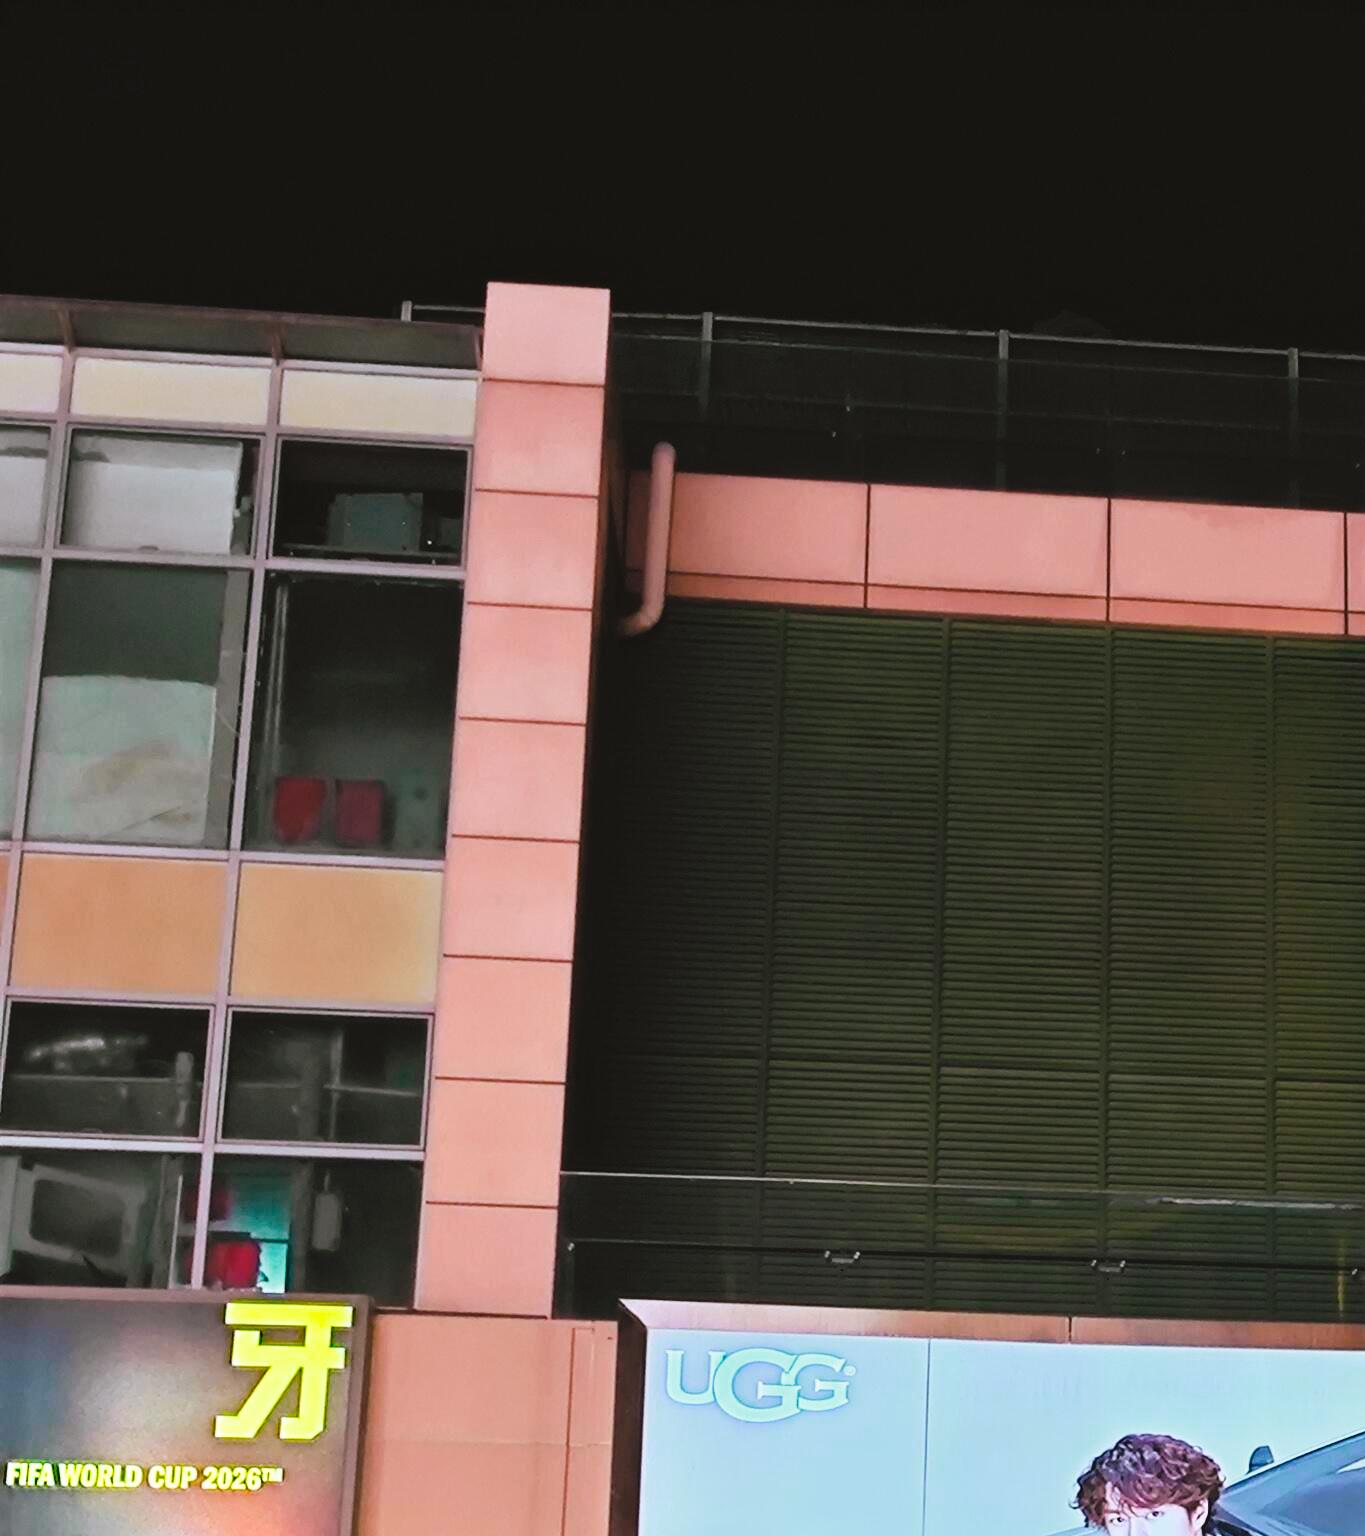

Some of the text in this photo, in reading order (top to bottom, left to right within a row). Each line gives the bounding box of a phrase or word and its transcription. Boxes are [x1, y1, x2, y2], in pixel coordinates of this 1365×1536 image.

[214, 1302, 353, 1440] 牙
[665, 1347, 851, 1422] UGG
[6, 1461, 53, 1486] FIFA
[58, 1462, 143, 1488] WORLD
[148, 1464, 198, 1490] CUP
